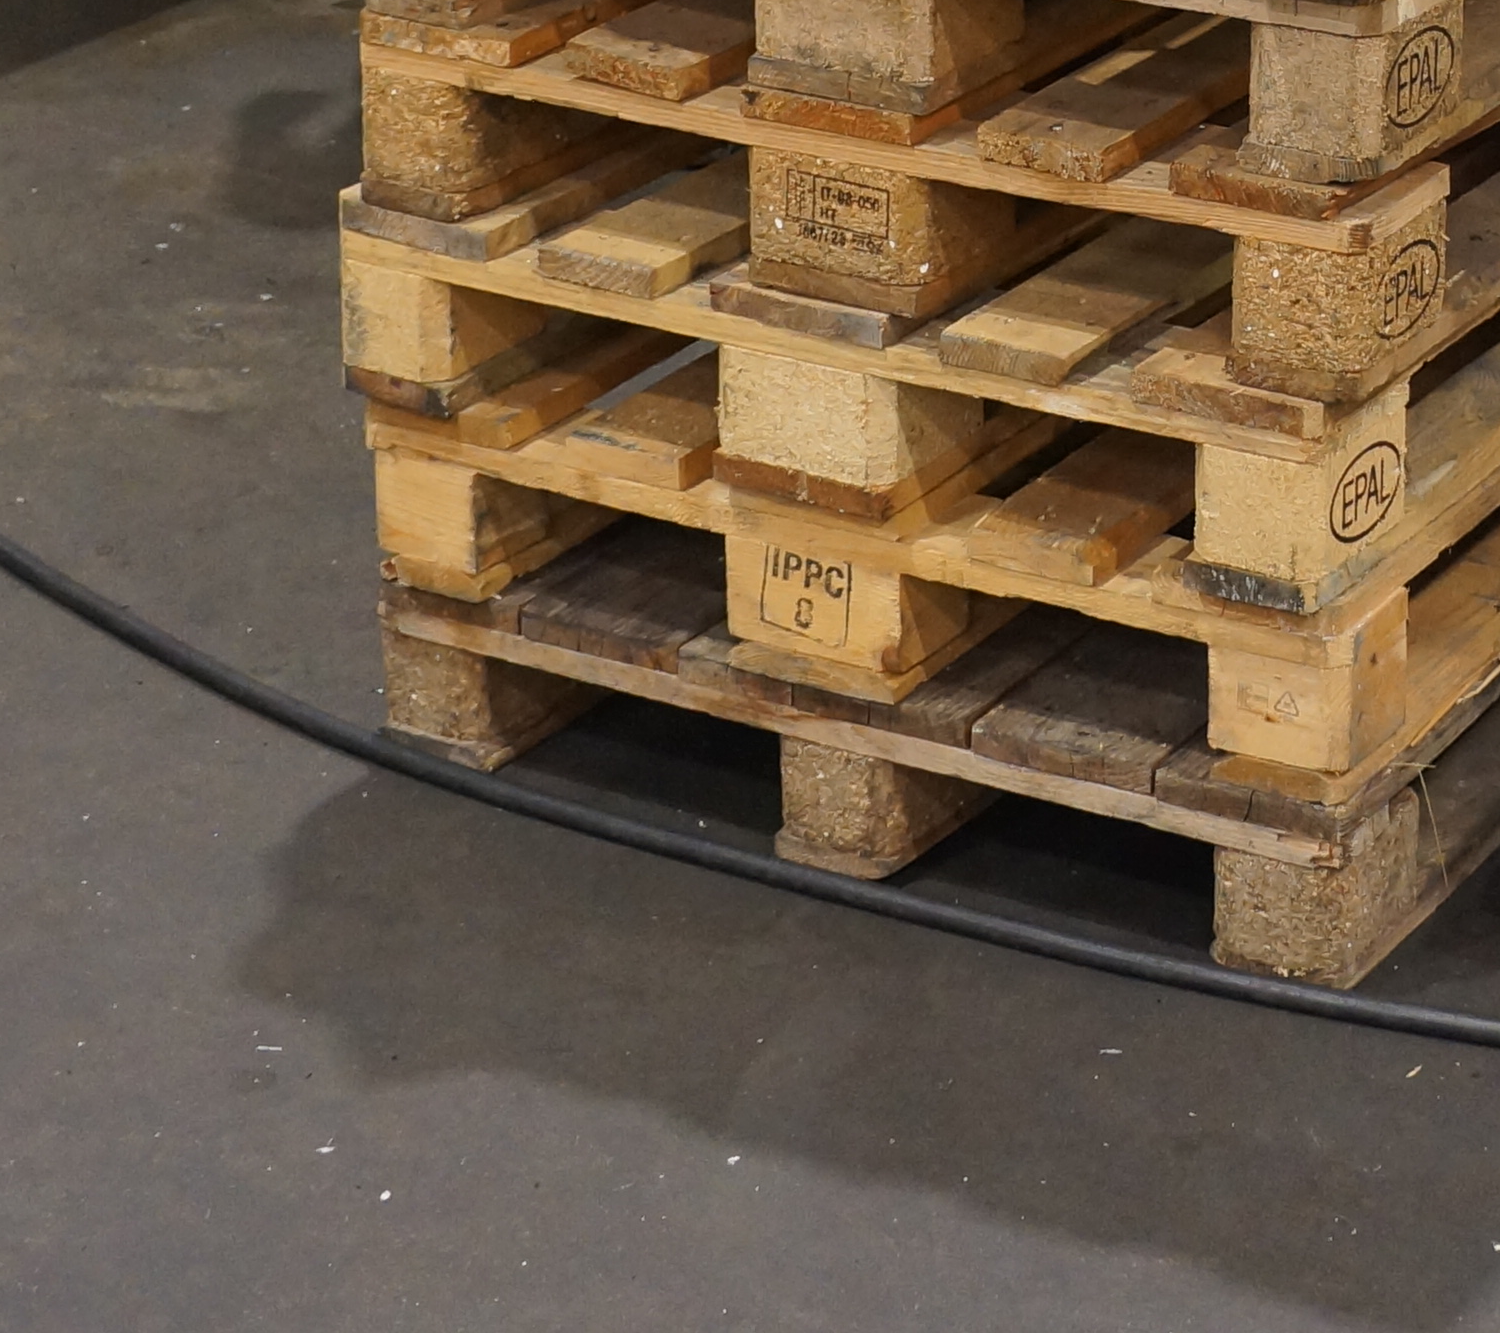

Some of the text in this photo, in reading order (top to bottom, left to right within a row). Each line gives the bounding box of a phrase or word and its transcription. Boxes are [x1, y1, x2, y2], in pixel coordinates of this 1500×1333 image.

[1396, 37, 1442, 118] EPAL
[1383, 254, 1430, 326] EPAL
[1341, 456, 1391, 531] EPAL
[771, 546, 845, 600] IPPC
